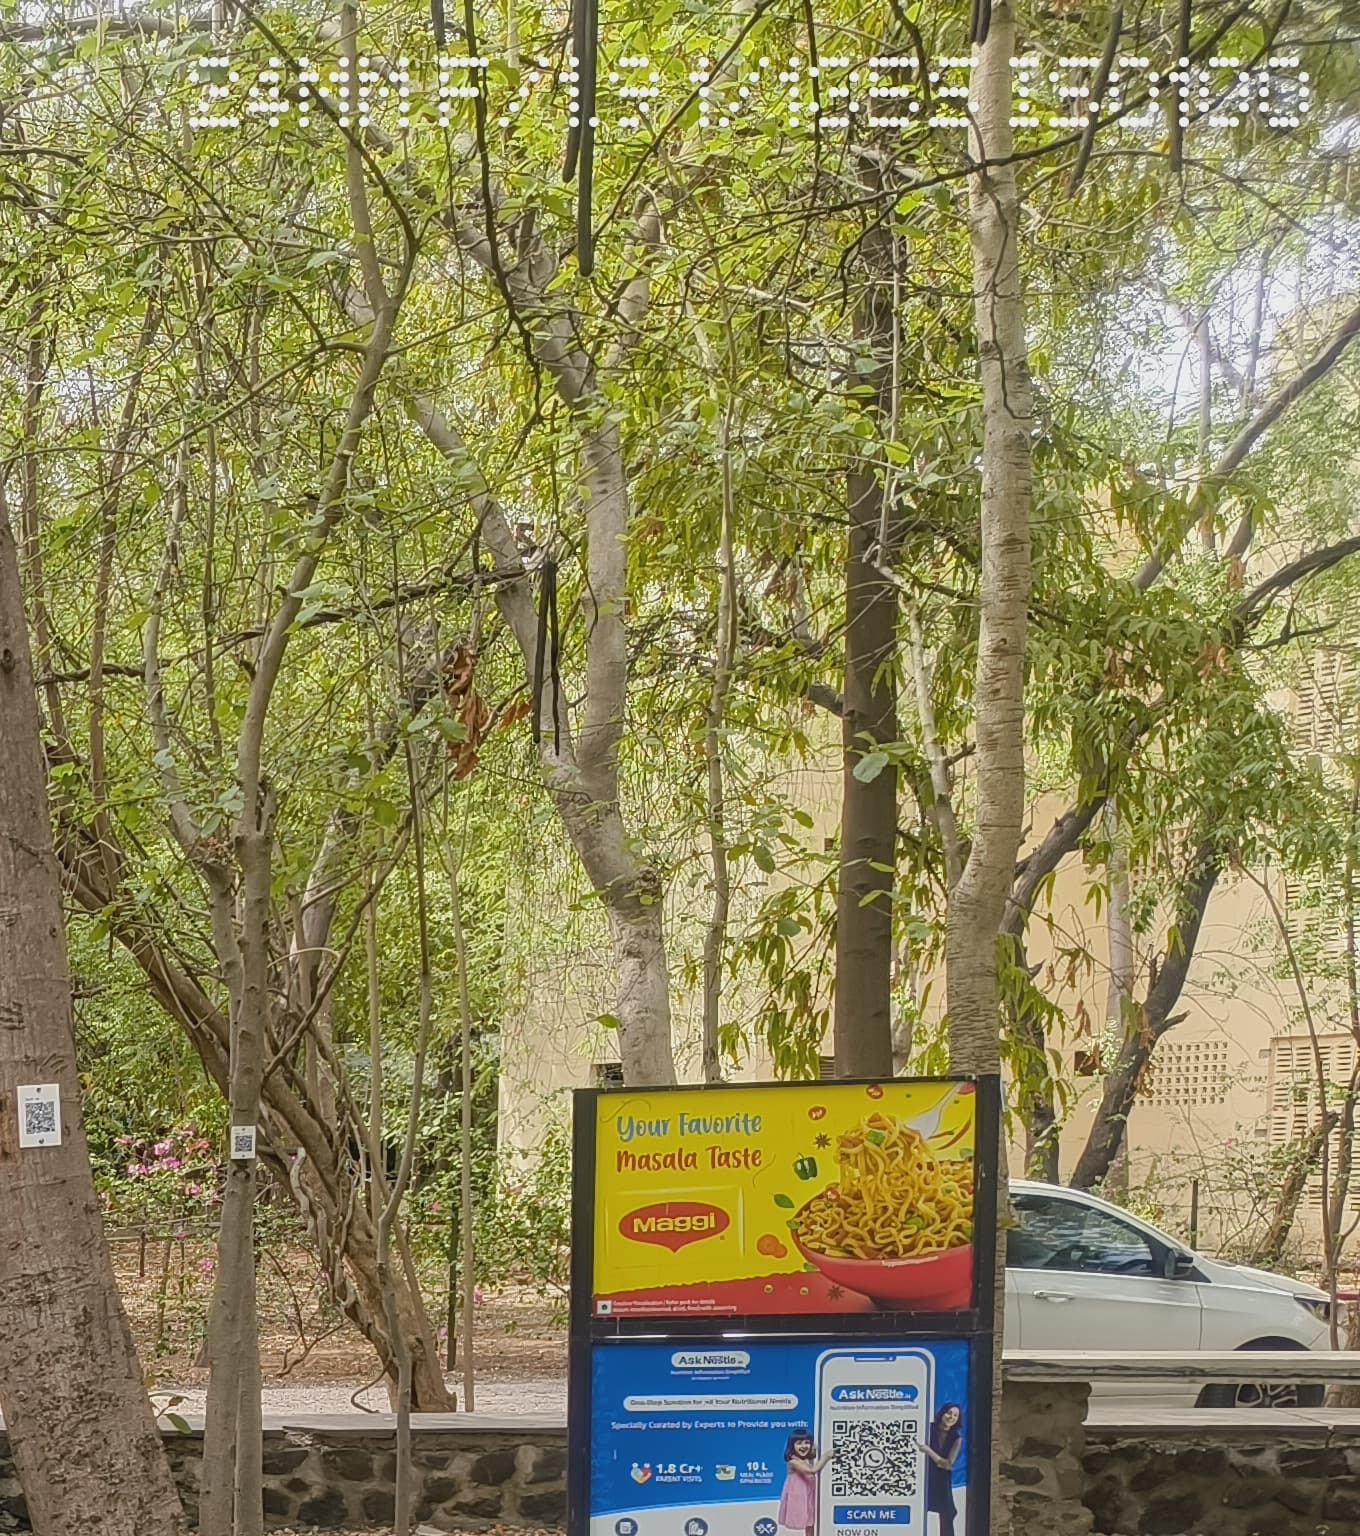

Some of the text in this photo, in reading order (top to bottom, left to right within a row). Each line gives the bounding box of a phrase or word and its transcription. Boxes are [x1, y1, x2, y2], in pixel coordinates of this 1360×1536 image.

[617, 1112, 762, 1143] Your Favorite
[705, 1145, 762, 1170] Taste
[633, 1212, 716, 1233] Maggi
[611, 1421, 646, 1431] Specially
[649, 1421, 680, 1429] Curated
[682, 1421, 692, 1431] by
[694, 1420, 725, 1430] Experts
[737, 1420, 768, 1428] Provide
[770, 1422, 786, 1430] you
[656, 1463, 702, 1474] 1.8 Cr+
[746, 1461, 768, 1471] 10 L
[846, 1510, 897, 1520] SCAN ME
[837, 1528, 879, 1536] NOW ON
